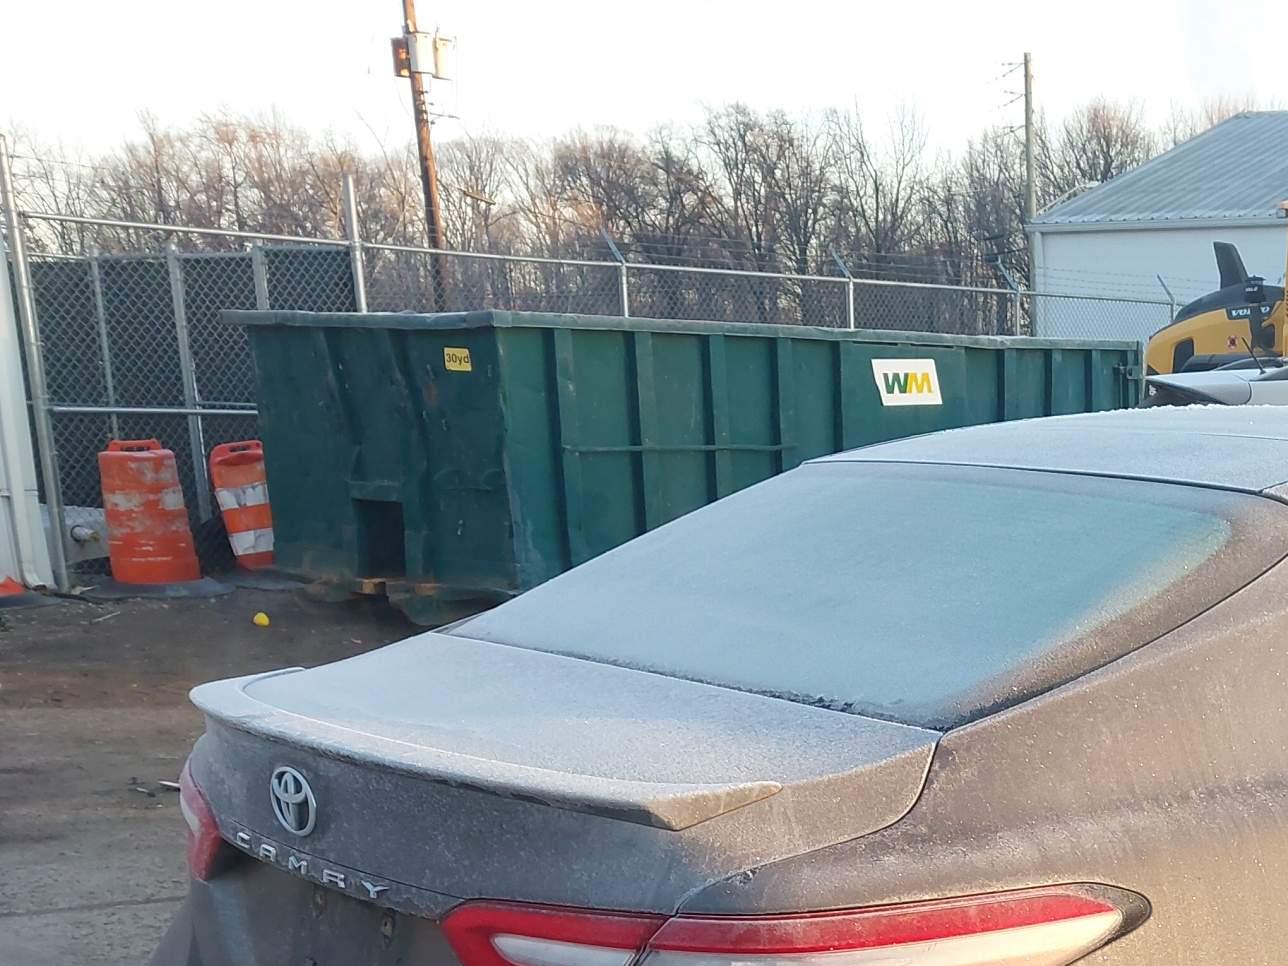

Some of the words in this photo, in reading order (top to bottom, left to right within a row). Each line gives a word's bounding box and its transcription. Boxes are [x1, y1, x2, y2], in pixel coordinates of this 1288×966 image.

[446, 352, 469, 366] 30yd
[882, 372, 932, 394] WM
[236, 831, 390, 899] CAMRY
